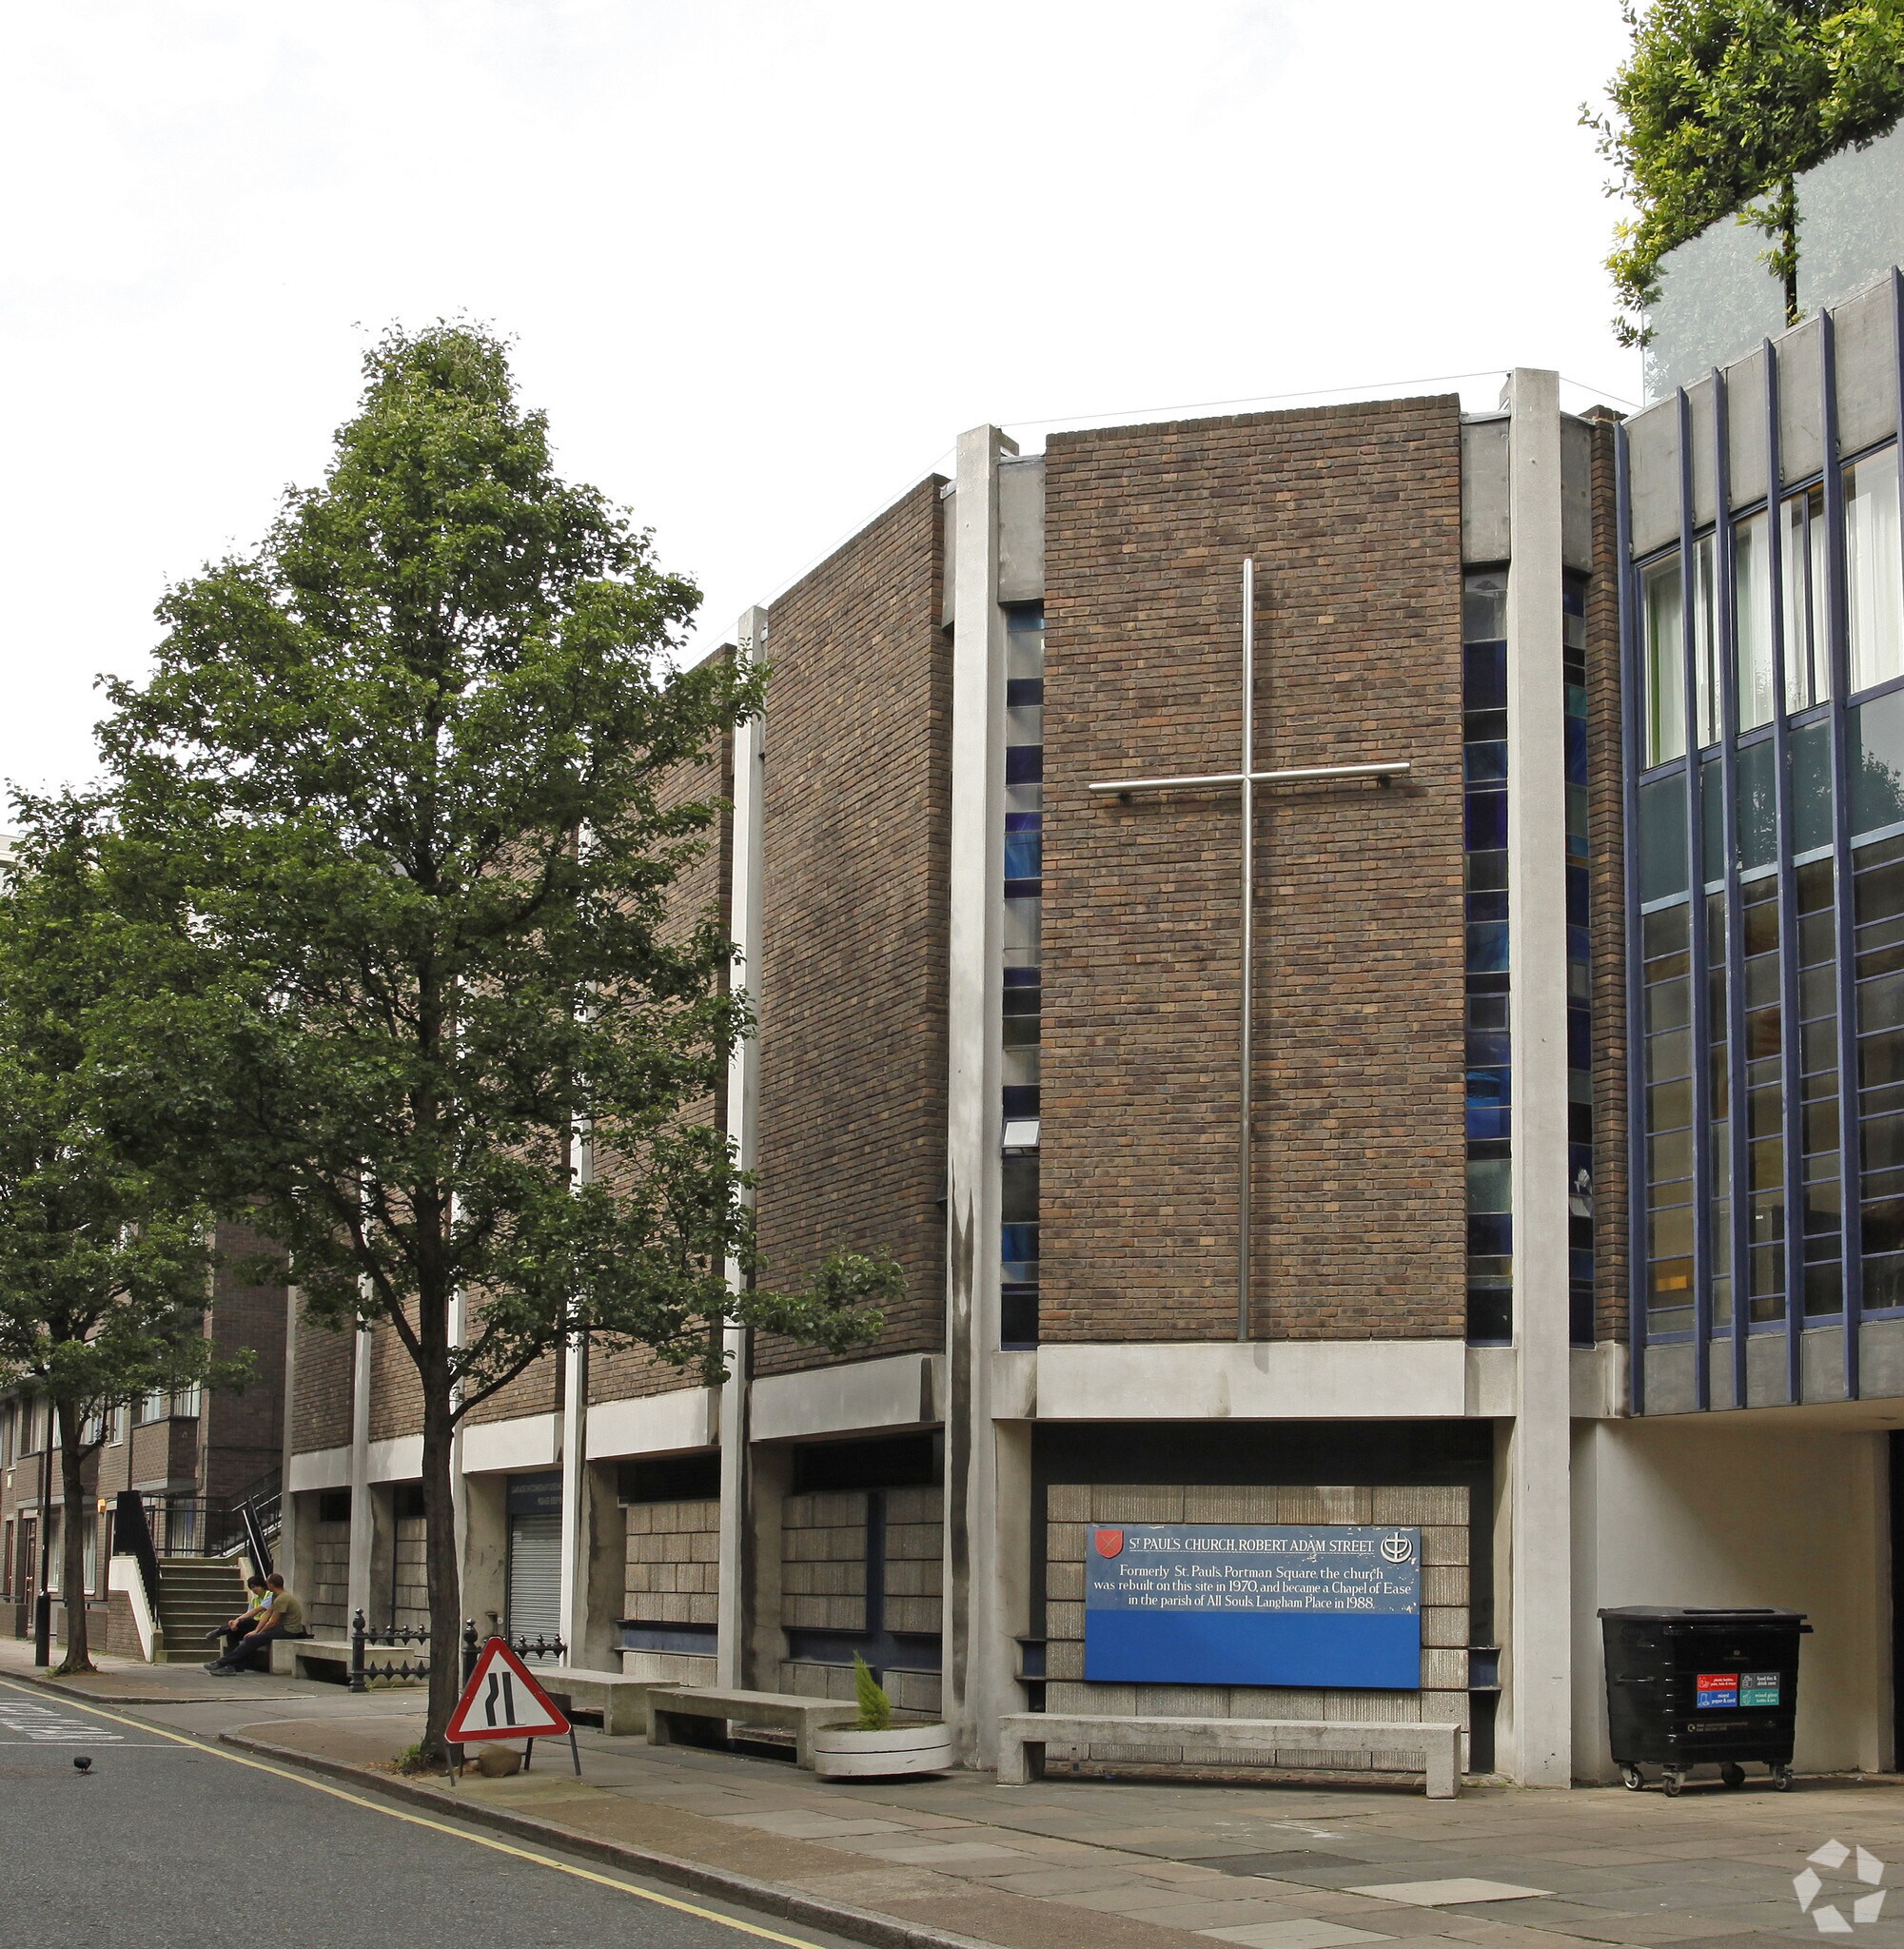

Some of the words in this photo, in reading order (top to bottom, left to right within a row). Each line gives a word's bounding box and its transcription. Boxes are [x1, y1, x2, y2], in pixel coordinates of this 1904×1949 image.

[1144, 1537, 1180, 1550] PAUL'S
[1238, 1539, 1288, 1551] ROBERT
[1290, 1539, 1325, 1552] ADAM
[1120, 1564, 1169, 1579] Formerly
[1175, 1565, 1189, 1577] St.
[1225, 1565, 1272, 1578] Portman
[1320, 1567, 1340, 1579] the
[1344, 1567, 1384, 1579] church
[1094, 1582, 1116, 1590] was
[1119, 1579, 1155, 1591] rebuilt
[1157, 1582, 1170, 1591] on
[1172, 1580, 1192, 1591] this
[1195, 1581, 1213, 1592] site
[1216, 1581, 1226, 1592] in
[1260, 1581, 1280, 1593] and
[1282, 1581, 1320, 1593] became
[1322, 1585, 1329, 1593] a
[1332, 1581, 1367, 1596] Chapel
[1369, 1582, 1381, 1594] of
[1384, 1582, 1411, 1594] Ease
[1128, 1594, 1138, 1605] in
[1140, 1594, 1158, 1605] the
[1160, 1595, 1192, 1608] parish
[1194, 1595, 1205, 1606] of
[1207, 1595, 1221, 1606] All
[1256, 1595, 1302, 1609] Langham
[1305, 1596, 1332, 1608] Place
[1335, 1597, 1344, 1608] in
[1346, 1596, 1374, 1609] 1988.
